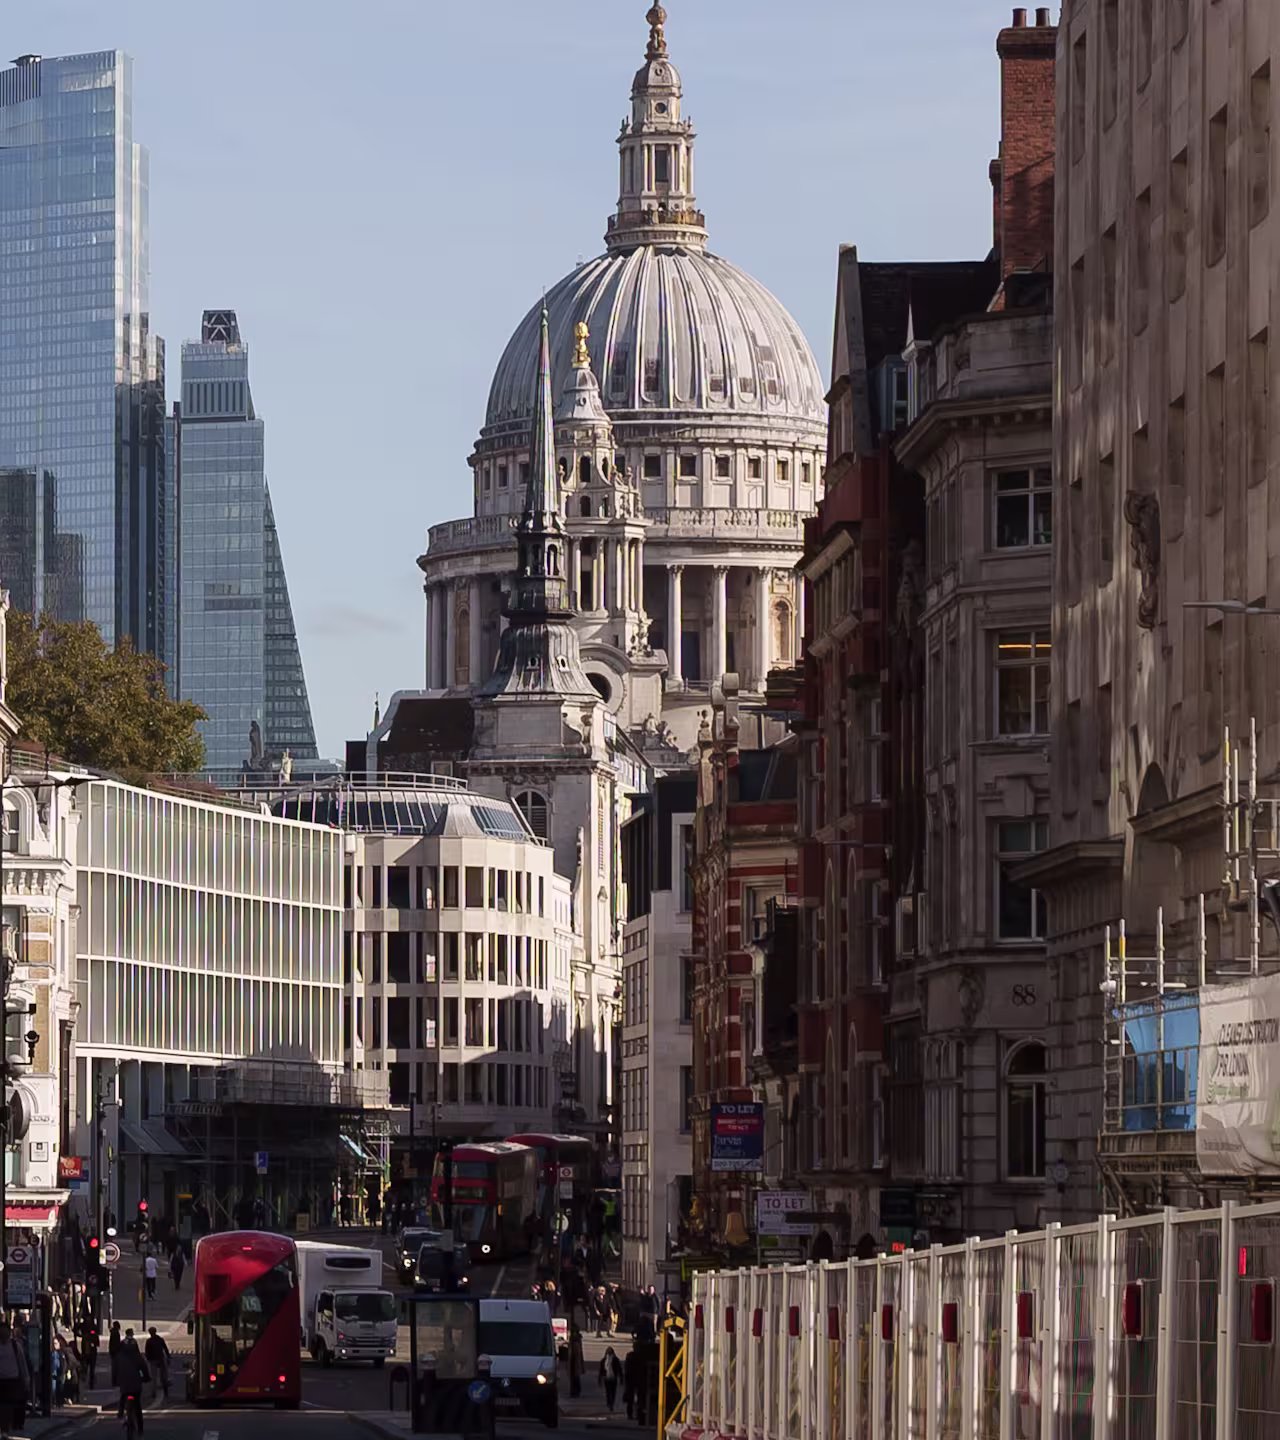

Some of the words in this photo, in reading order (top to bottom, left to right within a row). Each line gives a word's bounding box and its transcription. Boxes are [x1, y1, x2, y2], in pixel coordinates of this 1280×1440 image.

[1012, 984, 1037, 1007] 88
[721, 1105, 736, 1114] TO
[738, 1105, 756, 1114] LET
[61, 1168, 80, 1176] LEON
[764, 1198, 781, 1209] TO
[785, 1198, 805, 1209] LET
